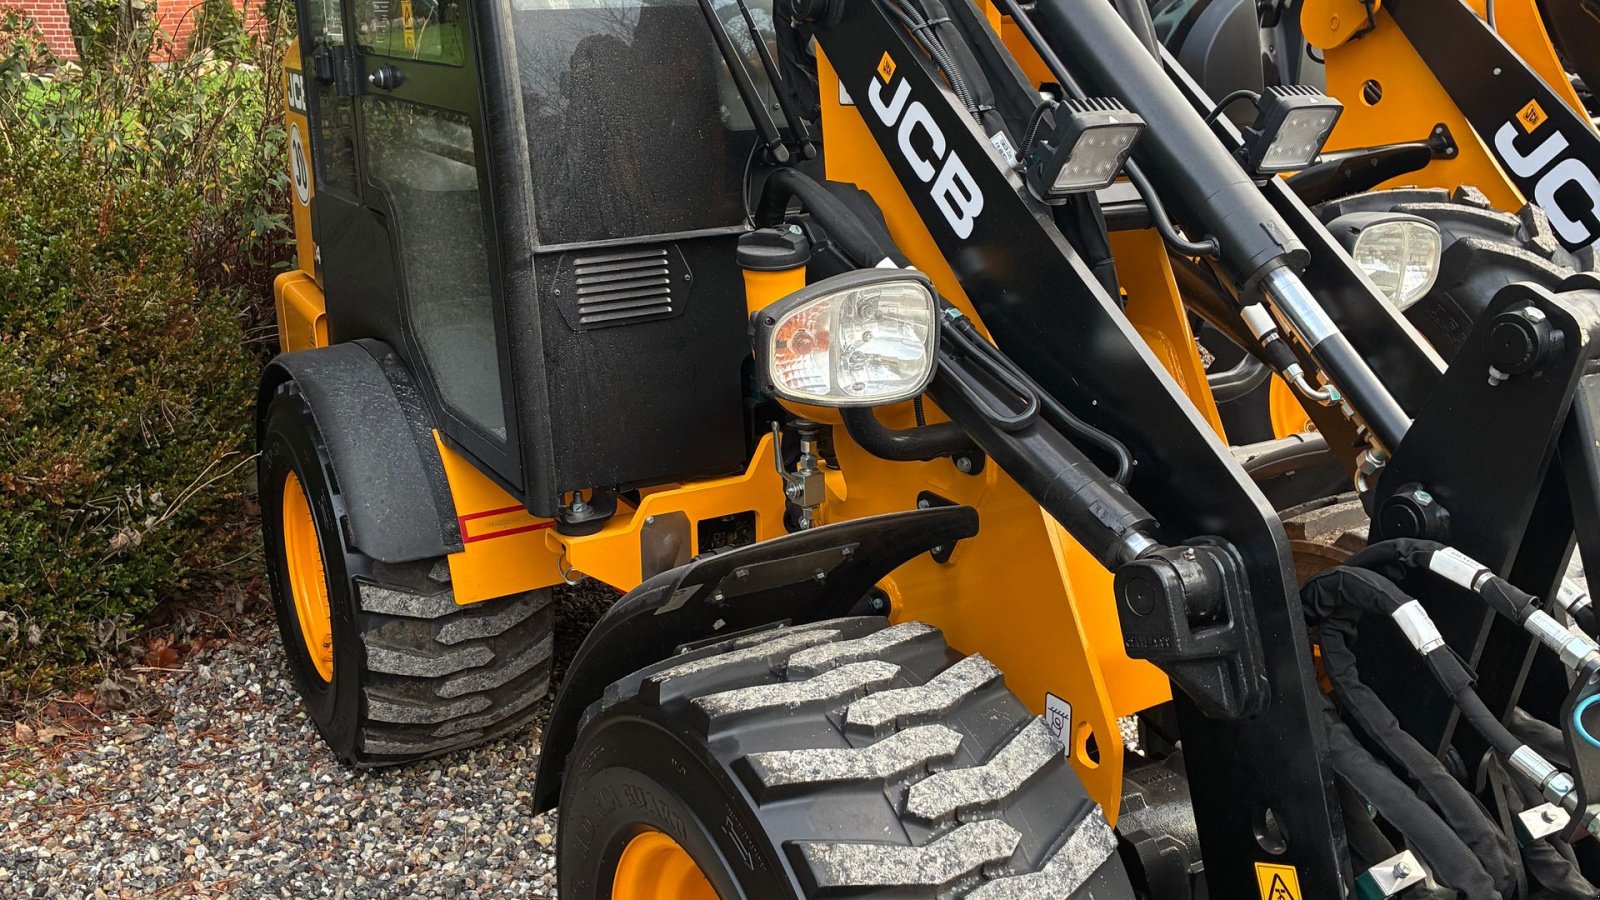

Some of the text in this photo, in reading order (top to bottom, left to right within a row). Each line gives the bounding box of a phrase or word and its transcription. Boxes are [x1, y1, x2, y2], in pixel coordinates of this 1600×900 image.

[293, 139, 308, 190] 30
[868, 76, 984, 240] JCB
[1495, 121, 1600, 246] JC
